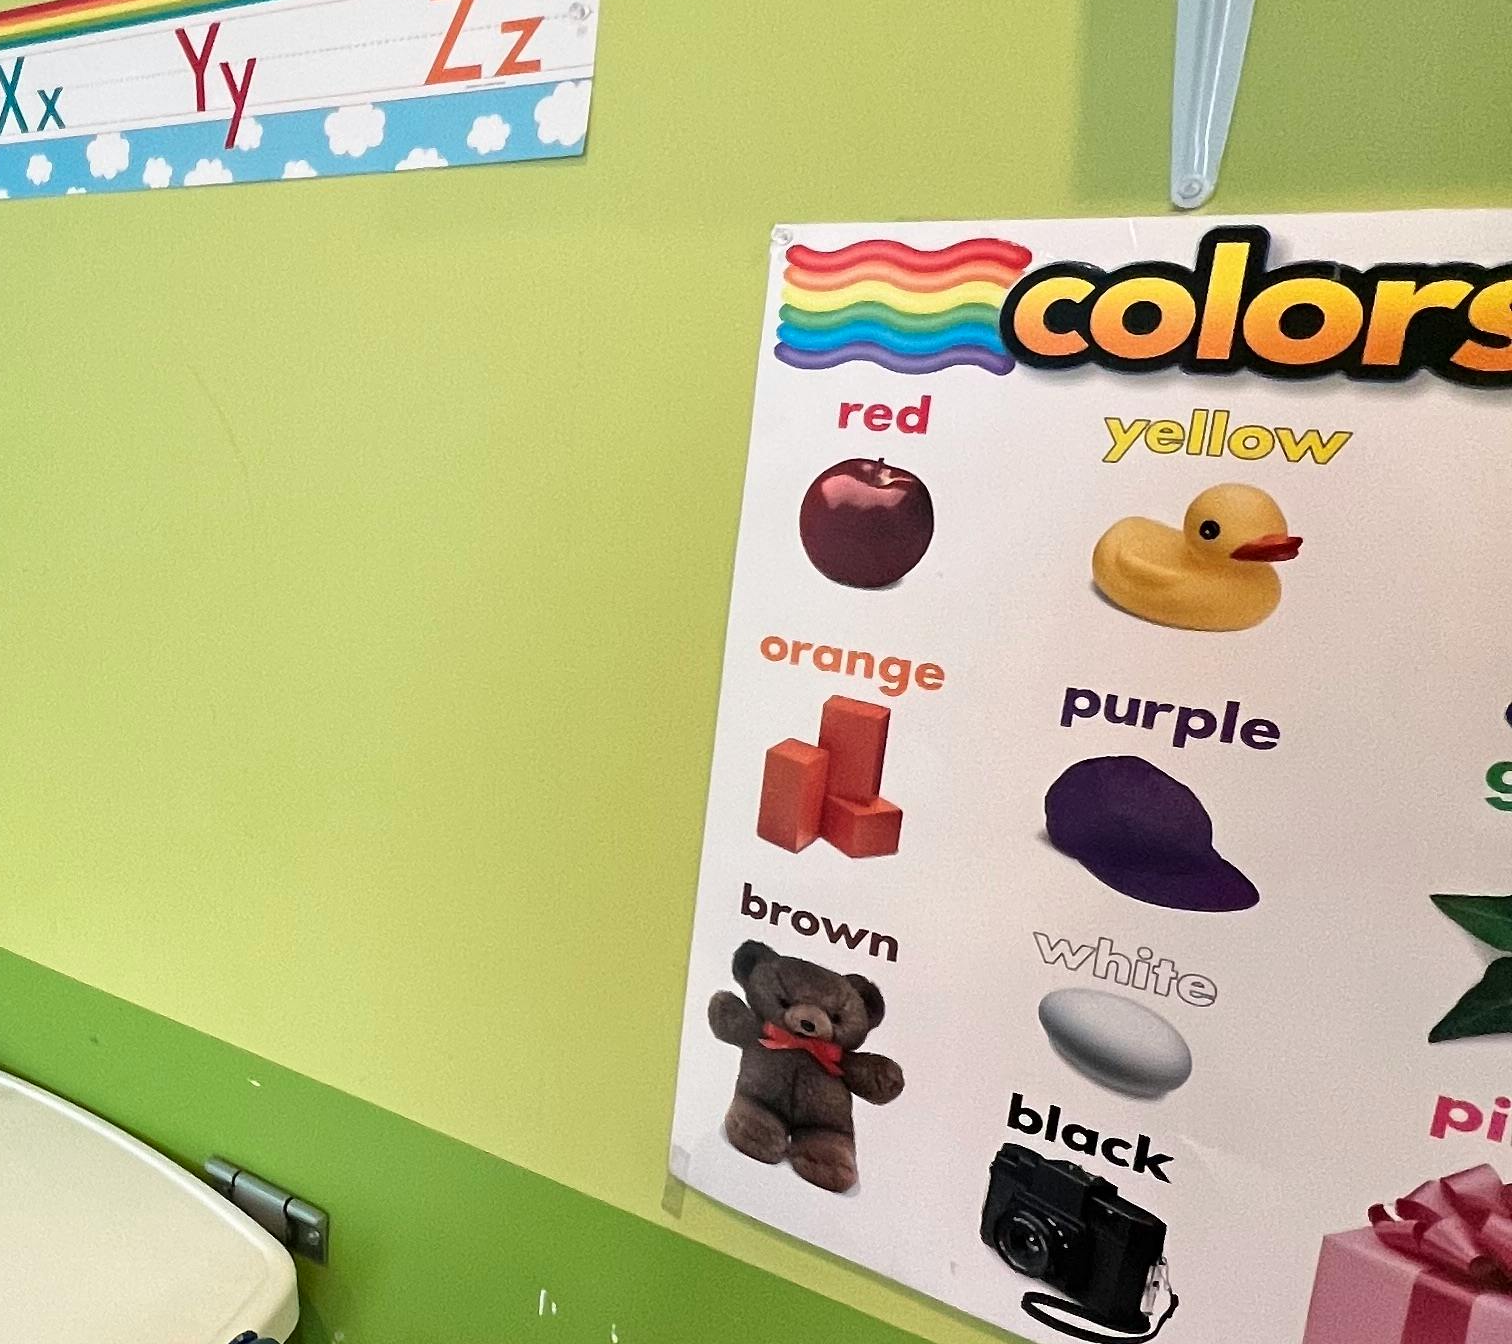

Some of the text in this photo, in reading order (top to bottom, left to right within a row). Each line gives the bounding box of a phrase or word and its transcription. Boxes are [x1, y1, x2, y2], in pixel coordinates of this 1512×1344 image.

[177, 24, 254, 150] Yy
[1006, 232, 1512, 376] colors
[837, 395, 930, 435] red
[1102, 410, 1353, 466] yellow
[759, 633, 945, 697] orange
[1060, 684, 1281, 751] purple
[739, 883, 900, 962] brown
[1032, 930, 1218, 1008] white
[1005, 1094, 1173, 1184] black
[1430, 1096, 1512, 1146] pi
